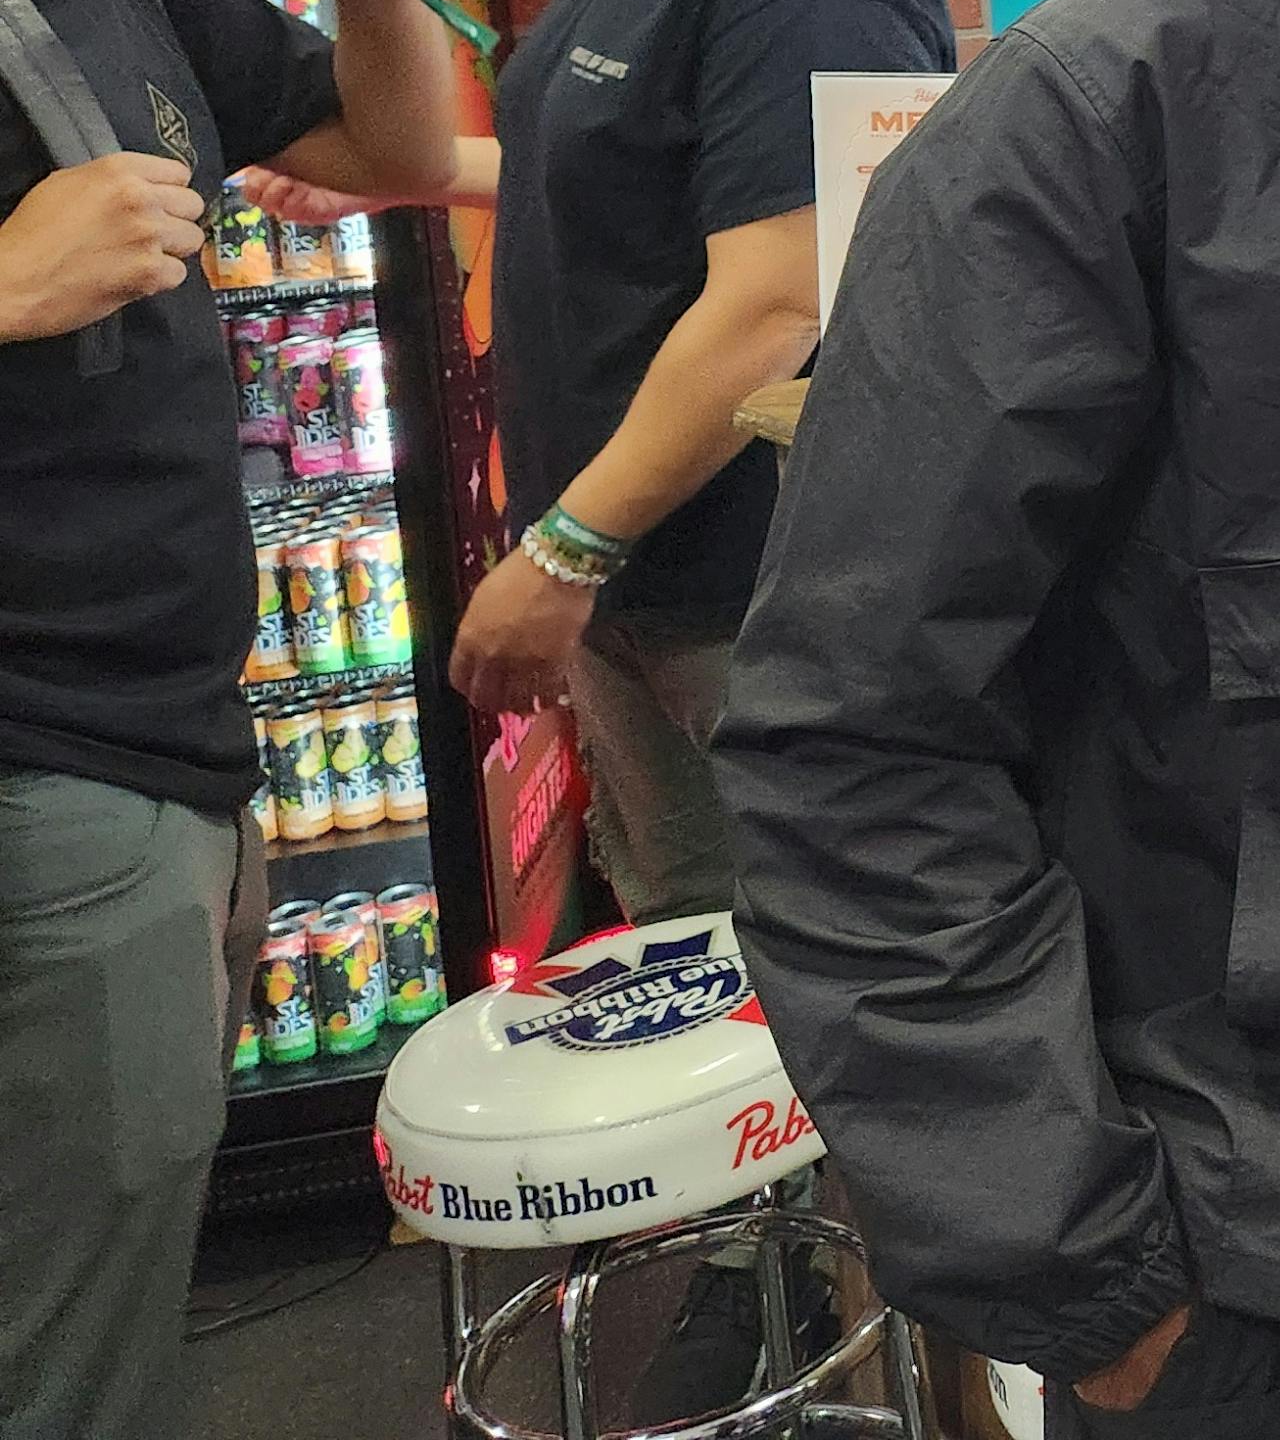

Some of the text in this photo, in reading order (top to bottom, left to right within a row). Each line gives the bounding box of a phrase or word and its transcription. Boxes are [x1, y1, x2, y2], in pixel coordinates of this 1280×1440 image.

[871, 111, 926, 132] ME
[513, 975, 681, 1036] Ribbon
[593, 979, 737, 1040] Pabst
[438, 1181, 513, 1222] Blue
[516, 1174, 659, 1221] Ribbon
[726, 1096, 816, 1170] Pab
